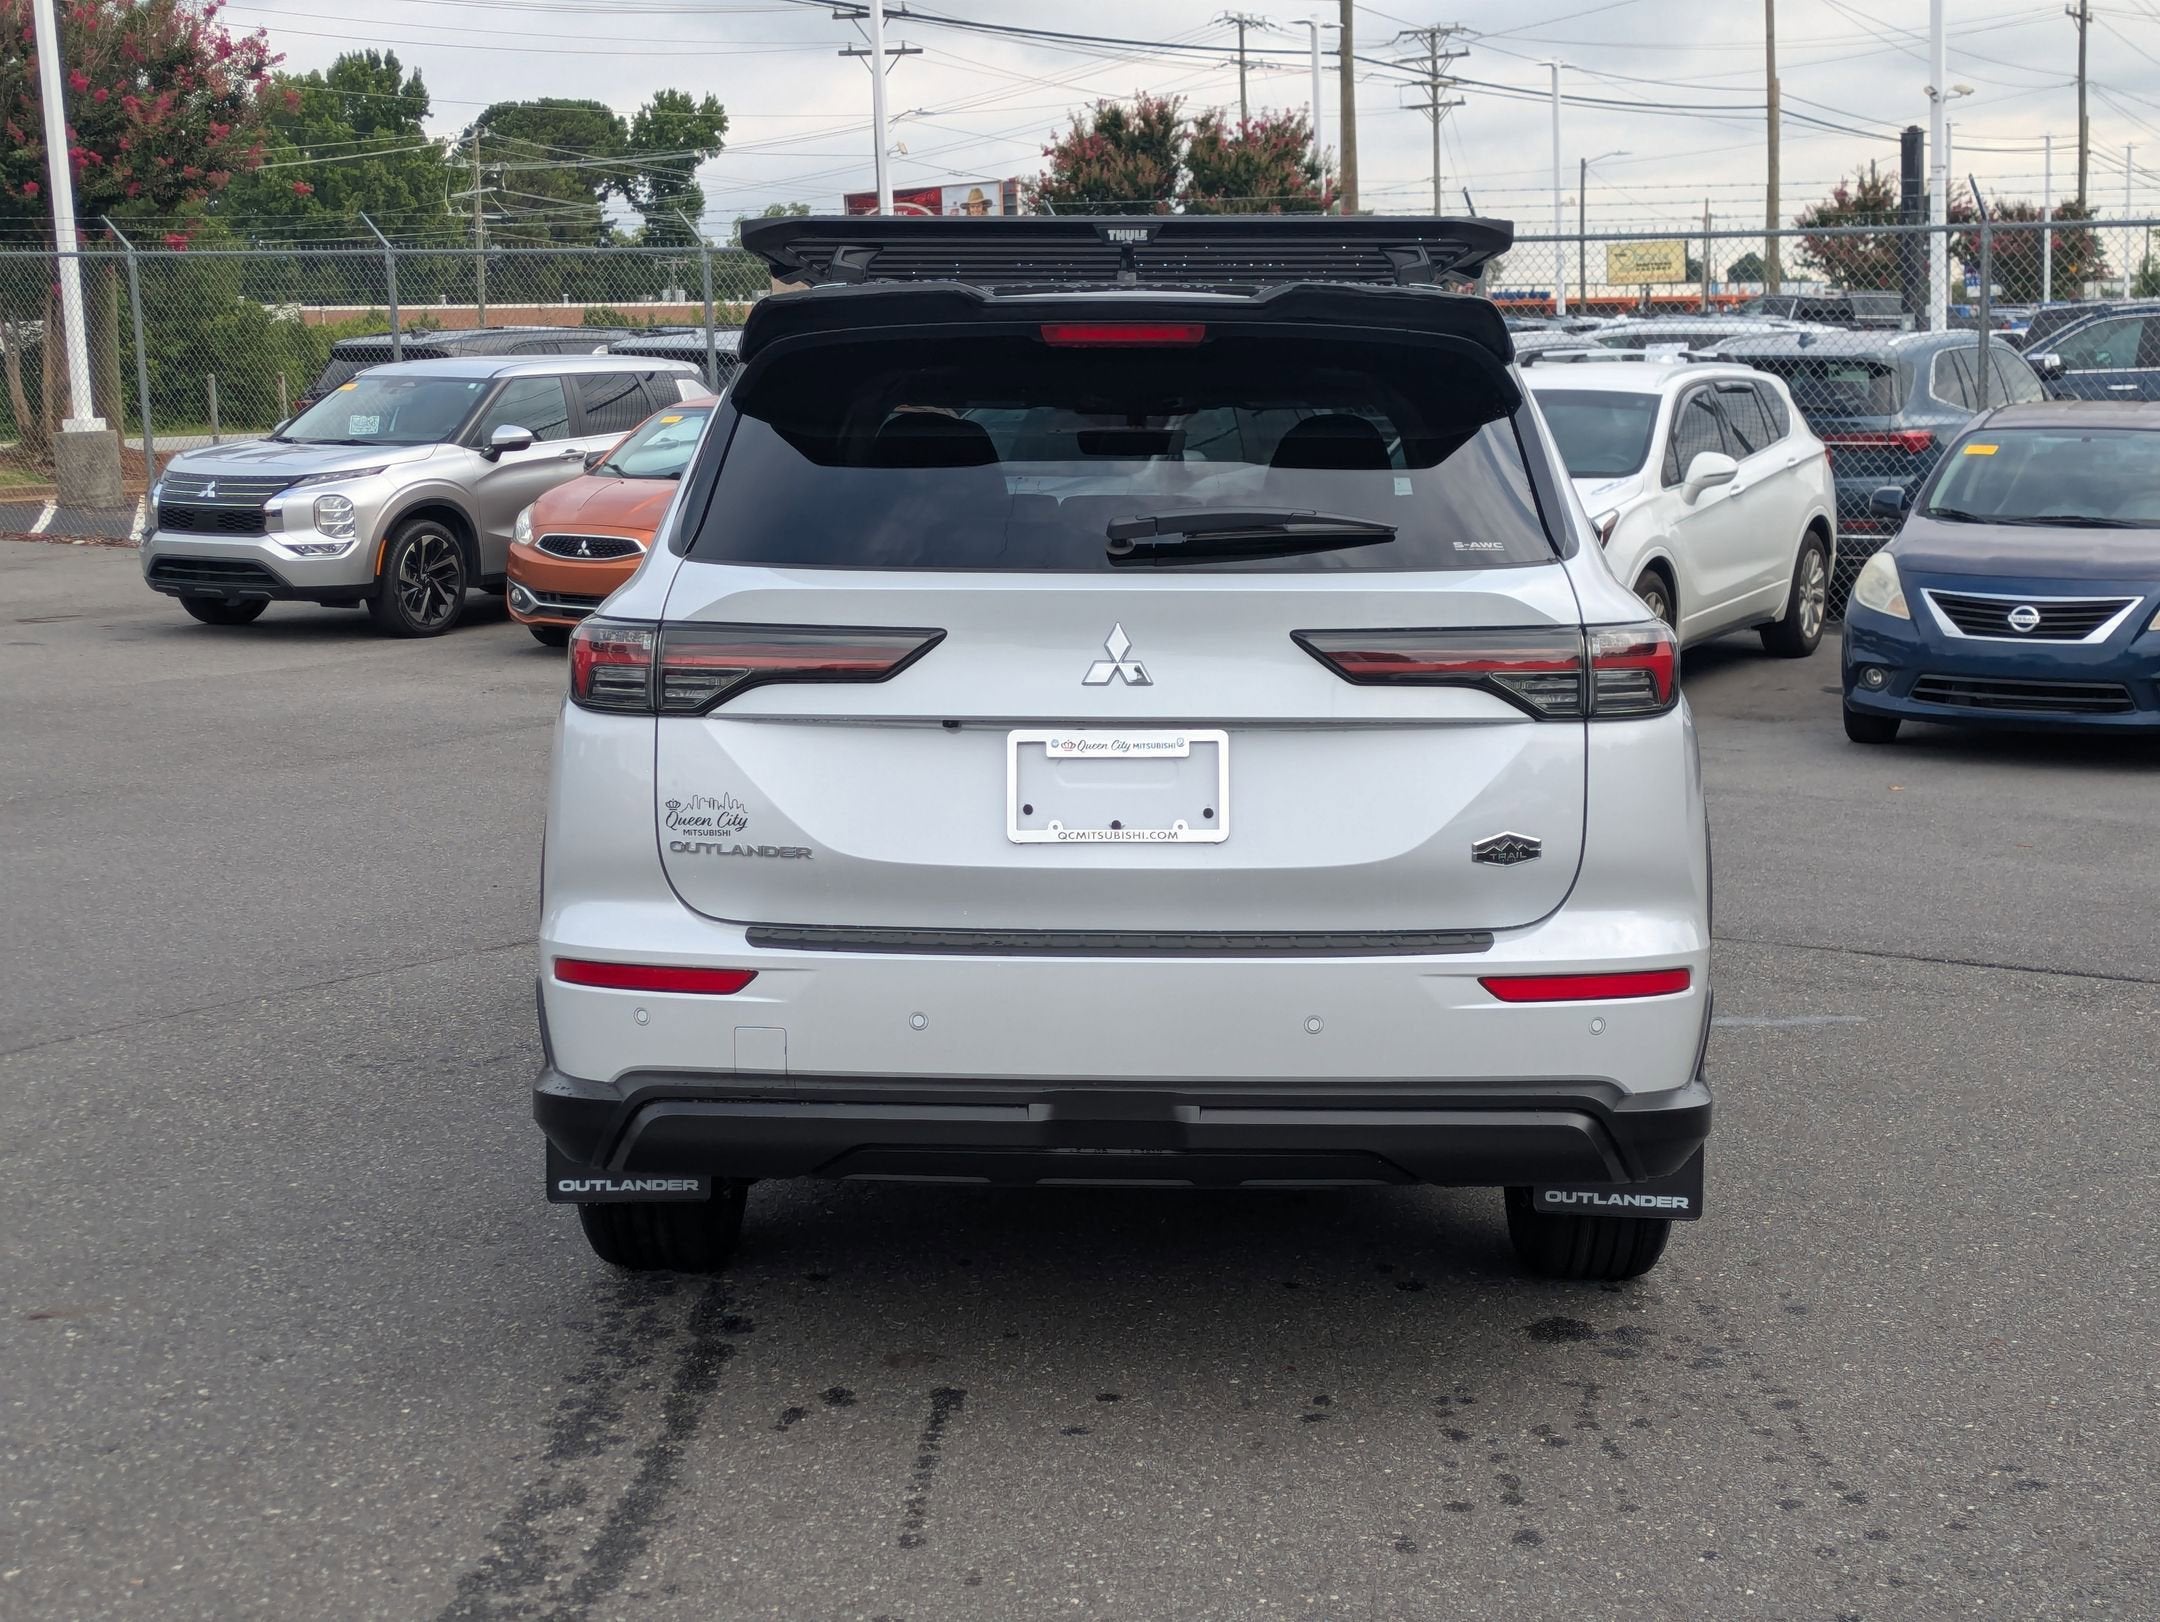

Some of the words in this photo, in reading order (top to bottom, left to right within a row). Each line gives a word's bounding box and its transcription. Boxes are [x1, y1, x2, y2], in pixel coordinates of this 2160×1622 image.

[1107, 229, 1148, 241] THULE
[1077, 739, 1108, 752] Queen
[1110, 739, 1131, 752] City
[665, 810, 713, 830] Queen
[716, 811, 749, 832] City
[682, 829, 731, 837] MITSUBISHI
[1057, 831, 1179, 840] QCMITSUBISHI.COM
[669, 840, 814, 859] OUTLANDER
[1489, 851, 1527, 860] TRAIL
[558, 1179, 699, 1192] OUTLANDER
[1544, 1190, 1689, 1209] OUTLANDER
